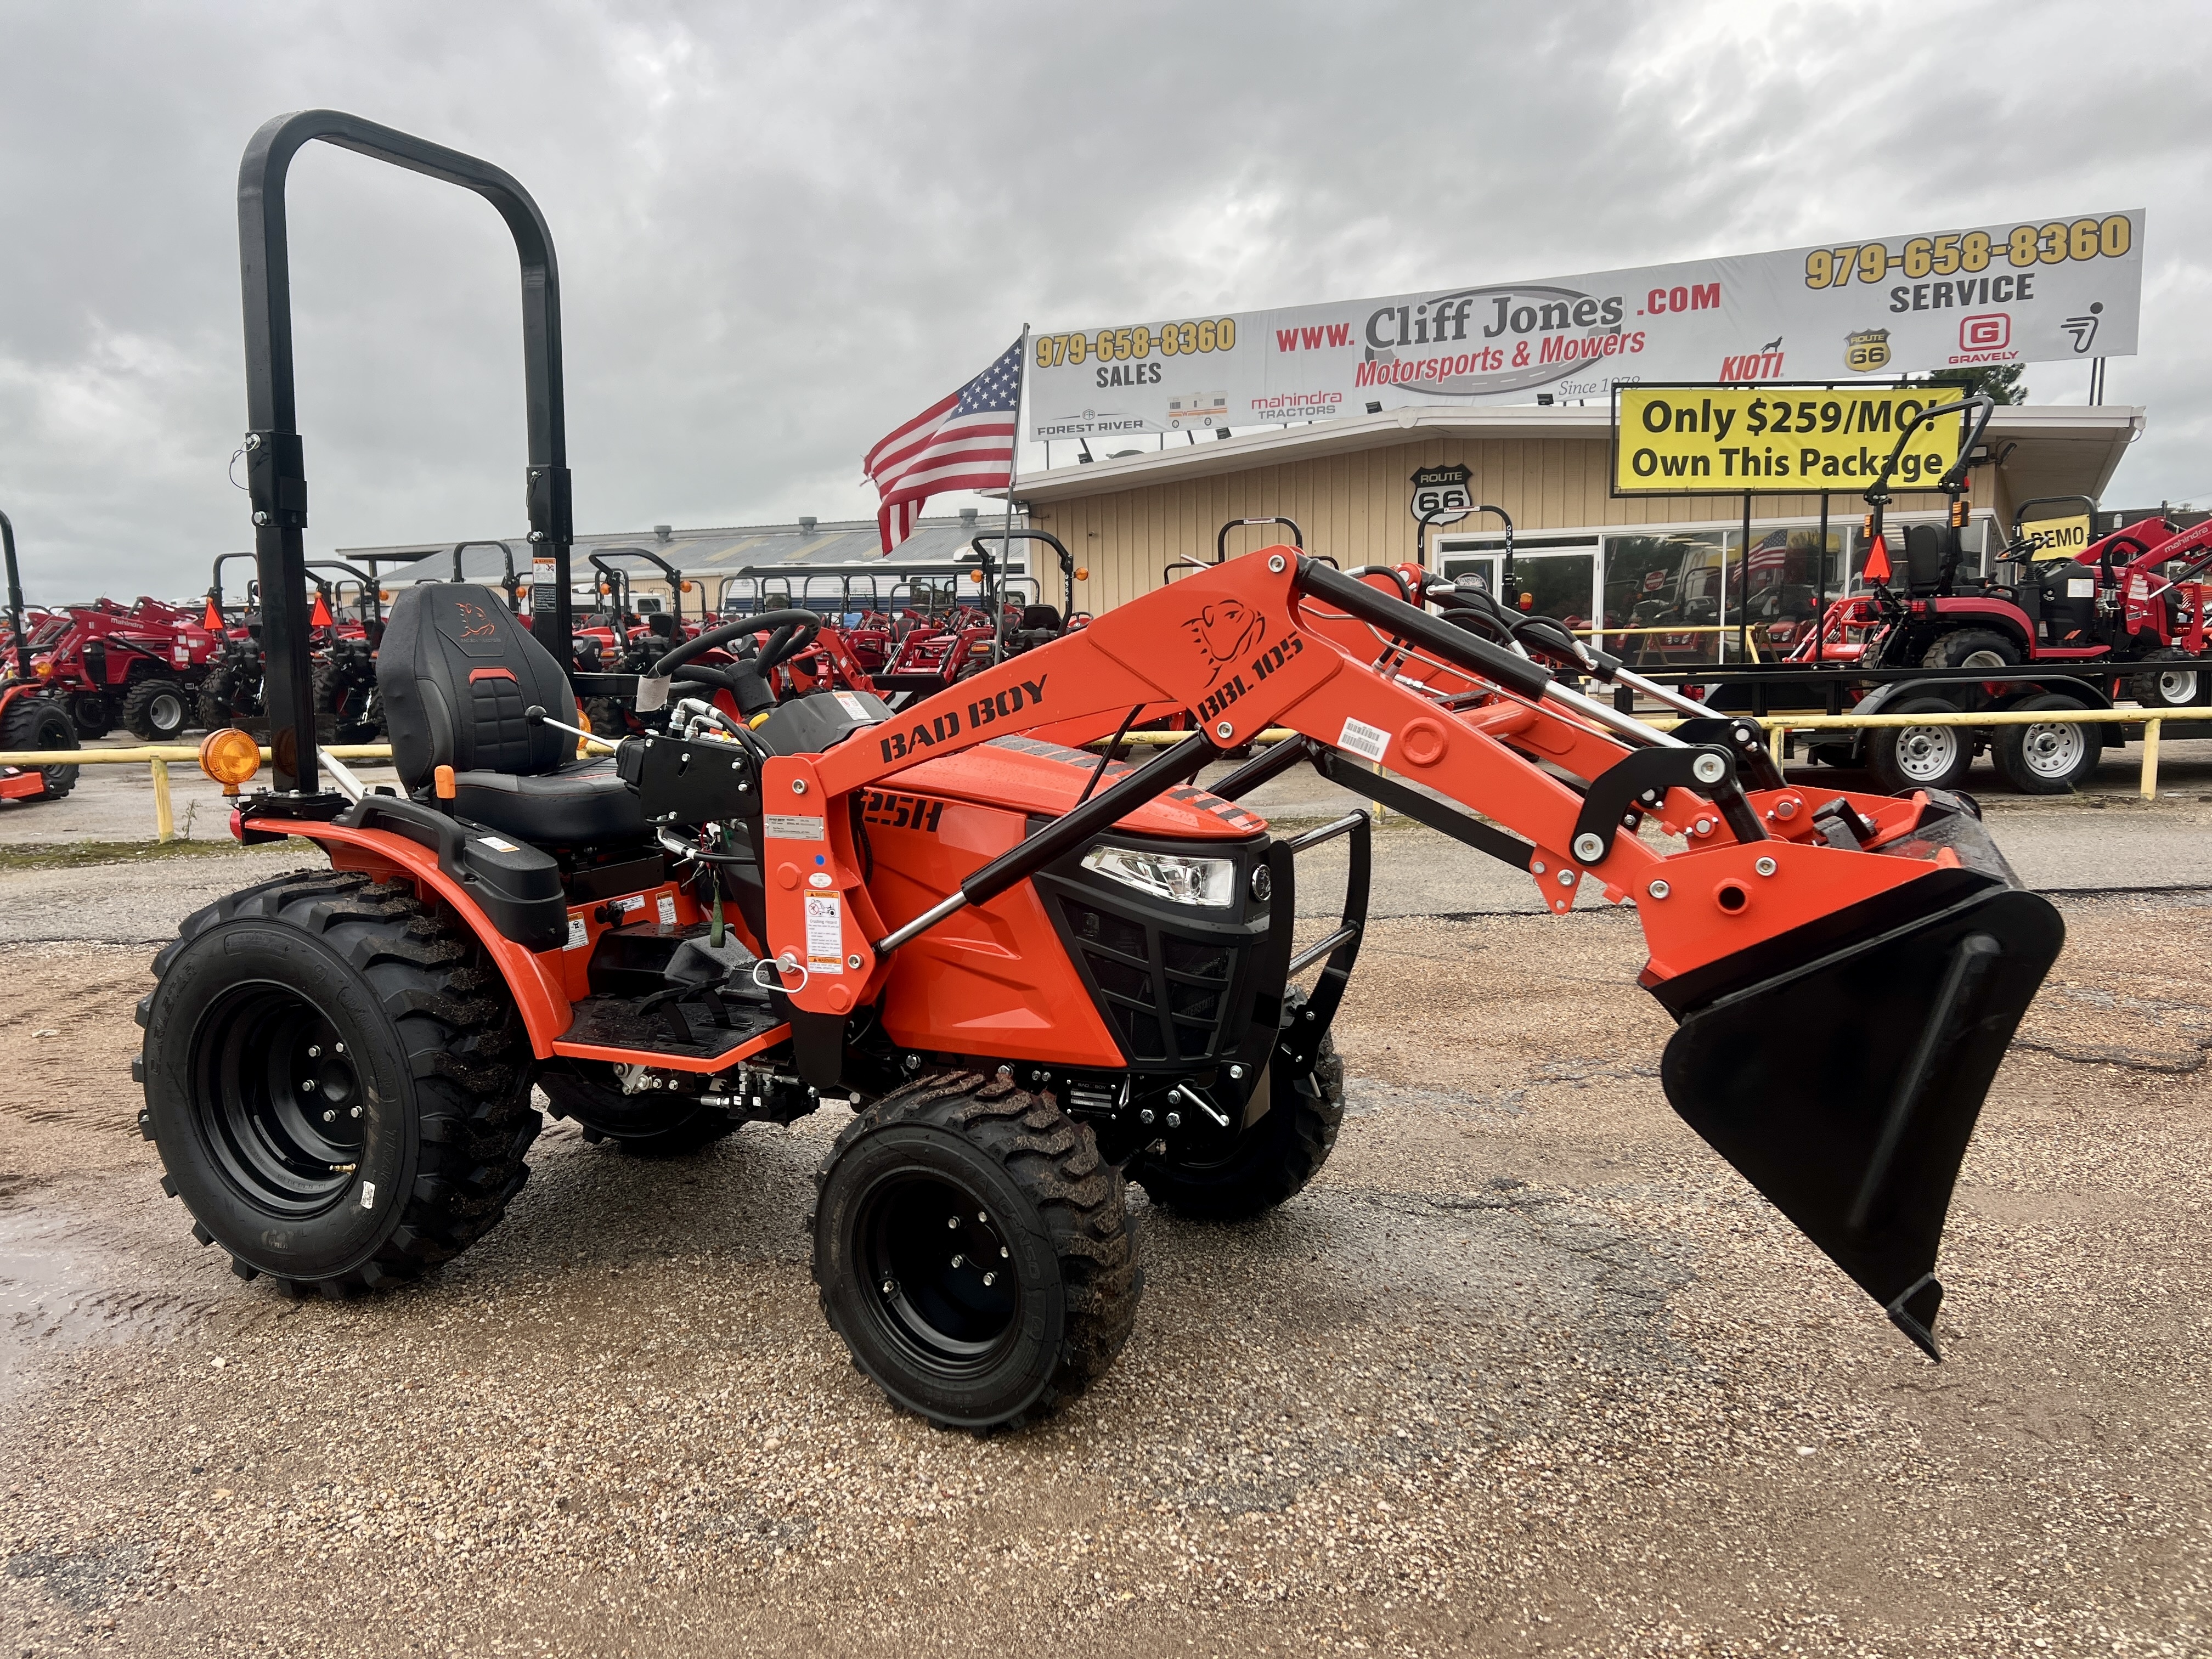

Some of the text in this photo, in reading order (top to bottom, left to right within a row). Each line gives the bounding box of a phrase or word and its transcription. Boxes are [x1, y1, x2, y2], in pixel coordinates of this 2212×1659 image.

[1805, 215, 2131, 290] 979-658-8360
[1637, 283, 1721, 315] .COM
[1889, 273, 2034, 313] SERVICE
[1365, 295, 1624, 350] Cliff Jones
[1036, 317, 1236, 368] 979-658-8360
[1850, 334, 1885, 345] ROUTE
[1355, 330, 1645, 388] Motorsports & Mowers
[1719, 352, 1785, 382] KIOTI
[1849, 346, 1886, 364] 66
[1948, 350, 2019, 365] GRAVELY
[1096, 362, 1161, 388] SALES
[1559, 380, 1596, 396] Since
[1251, 390, 1342, 410] mahindra
[1258, 405, 1336, 420] TRACTORS
[1037, 420, 1143, 436] FOREST RIVER
[1643, 398, 1938, 442] Only $259/MO!
[1420, 471, 1463, 483] ROUTE
[1632, 447, 1943, 483] Own This Package
[1418, 490, 1464, 512] 66
[2164, 526, 2209, 553] mahindra
[1198, 631, 1304, 723] BBL 105
[881, 674, 1048, 764] BAD BOY
